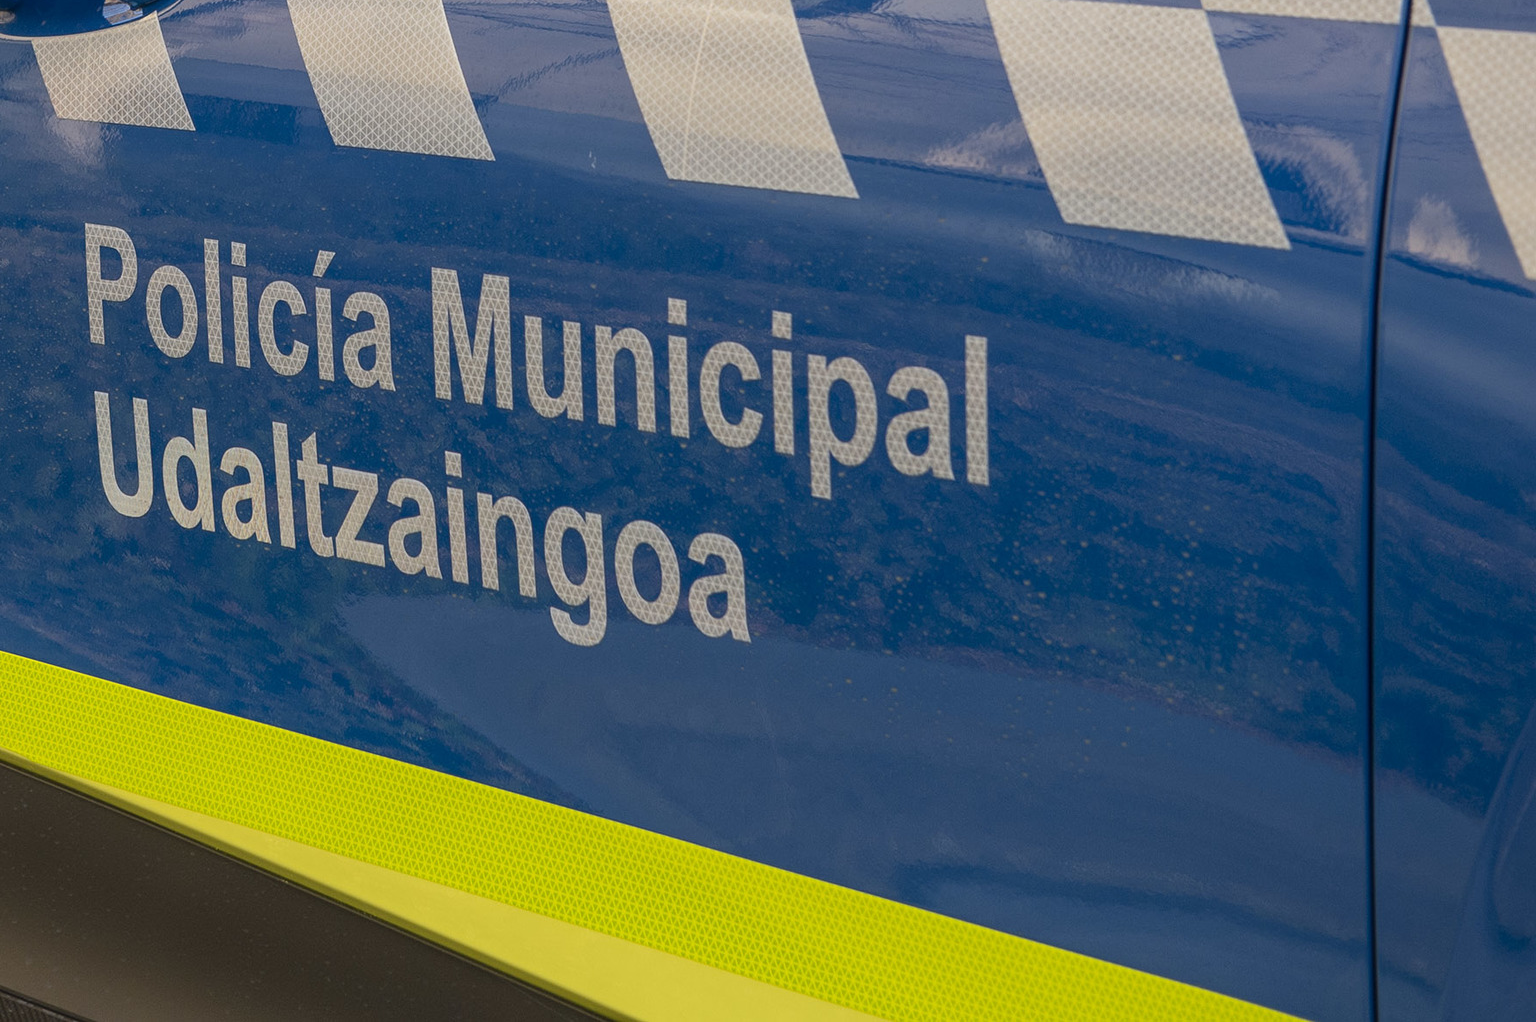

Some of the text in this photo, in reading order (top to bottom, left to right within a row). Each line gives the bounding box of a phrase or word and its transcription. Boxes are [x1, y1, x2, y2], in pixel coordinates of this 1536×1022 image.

[84, 222, 990, 500] Policía Municipal
[94, 390, 752, 648] Udaltzaingoa
